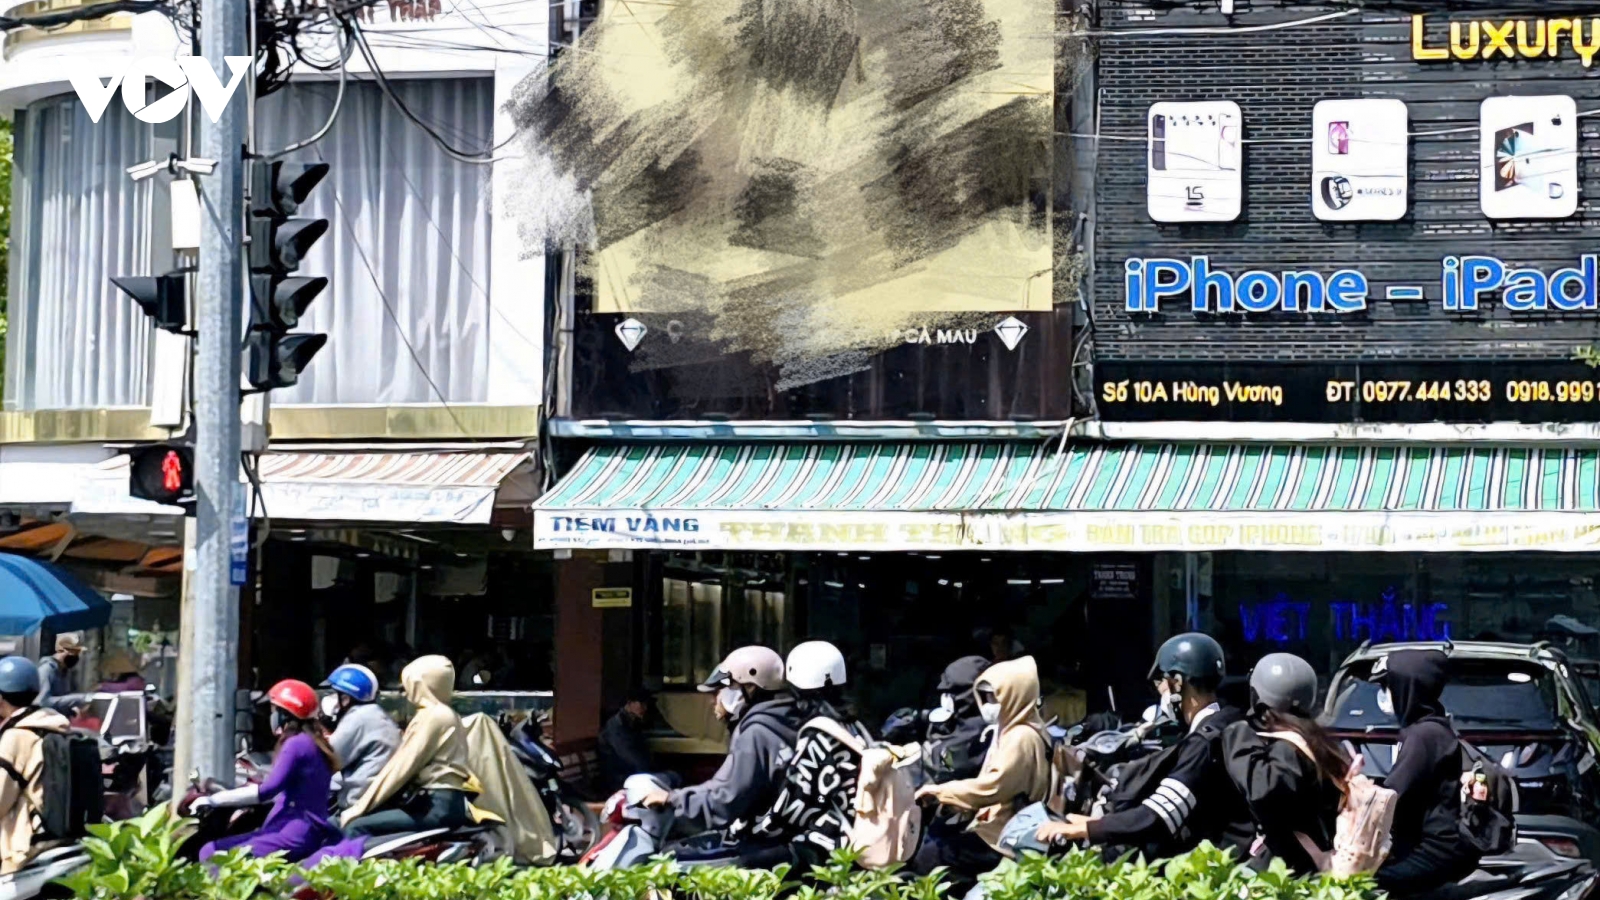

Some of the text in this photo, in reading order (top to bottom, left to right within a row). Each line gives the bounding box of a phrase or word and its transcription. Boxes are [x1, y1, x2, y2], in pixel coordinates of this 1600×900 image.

[1412, 14, 1600, 67] Luxury
[1125, 255, 1367, 312] iPhone
[1442, 254, 1597, 310] iPad
[937, 329, 977, 344] MAU
[1103, 379, 1130, 402] Số
[1133, 381, 1168, 402] 10A
[1172, 381, 1219, 406] Hùng
[1223, 381, 1283, 406] Vương
